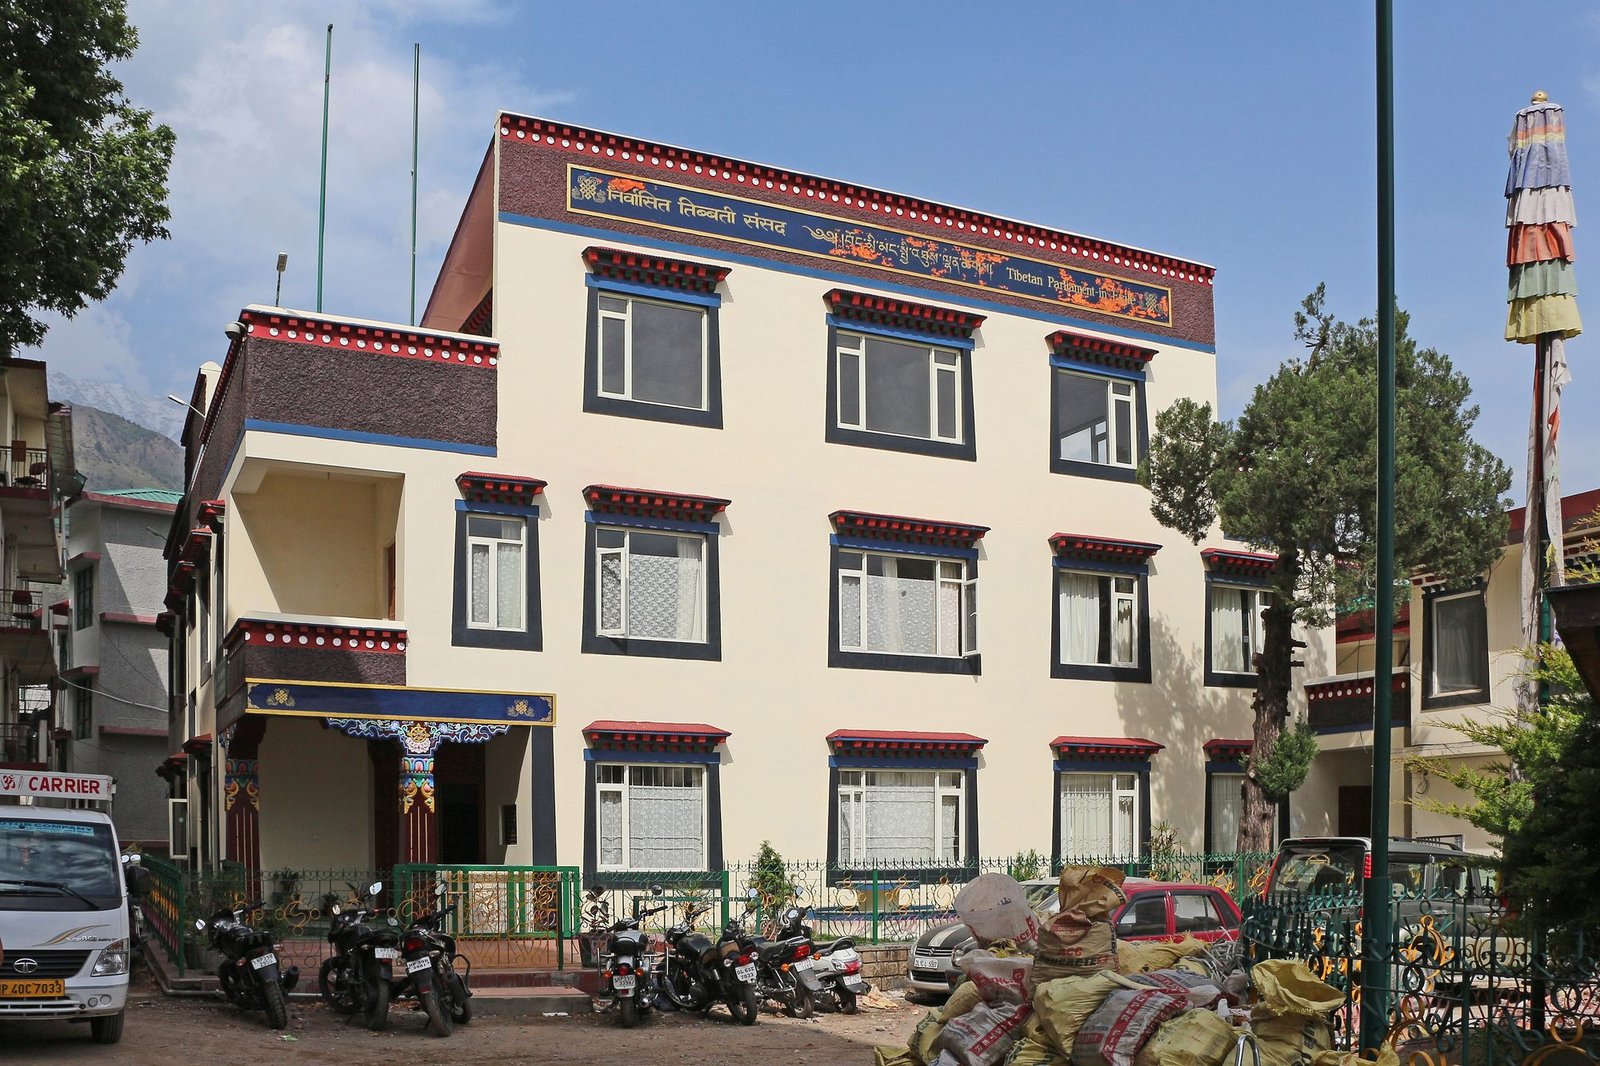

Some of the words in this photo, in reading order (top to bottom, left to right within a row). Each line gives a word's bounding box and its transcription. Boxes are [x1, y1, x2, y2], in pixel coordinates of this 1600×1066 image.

[677, 196, 737, 226] तिब्बती
[743, 212, 787, 237] संसद
[1006, 267, 1043, 287] Tibetan
[28, 776, 100, 794] CARRIER
[33, 983, 61, 994] 7033
